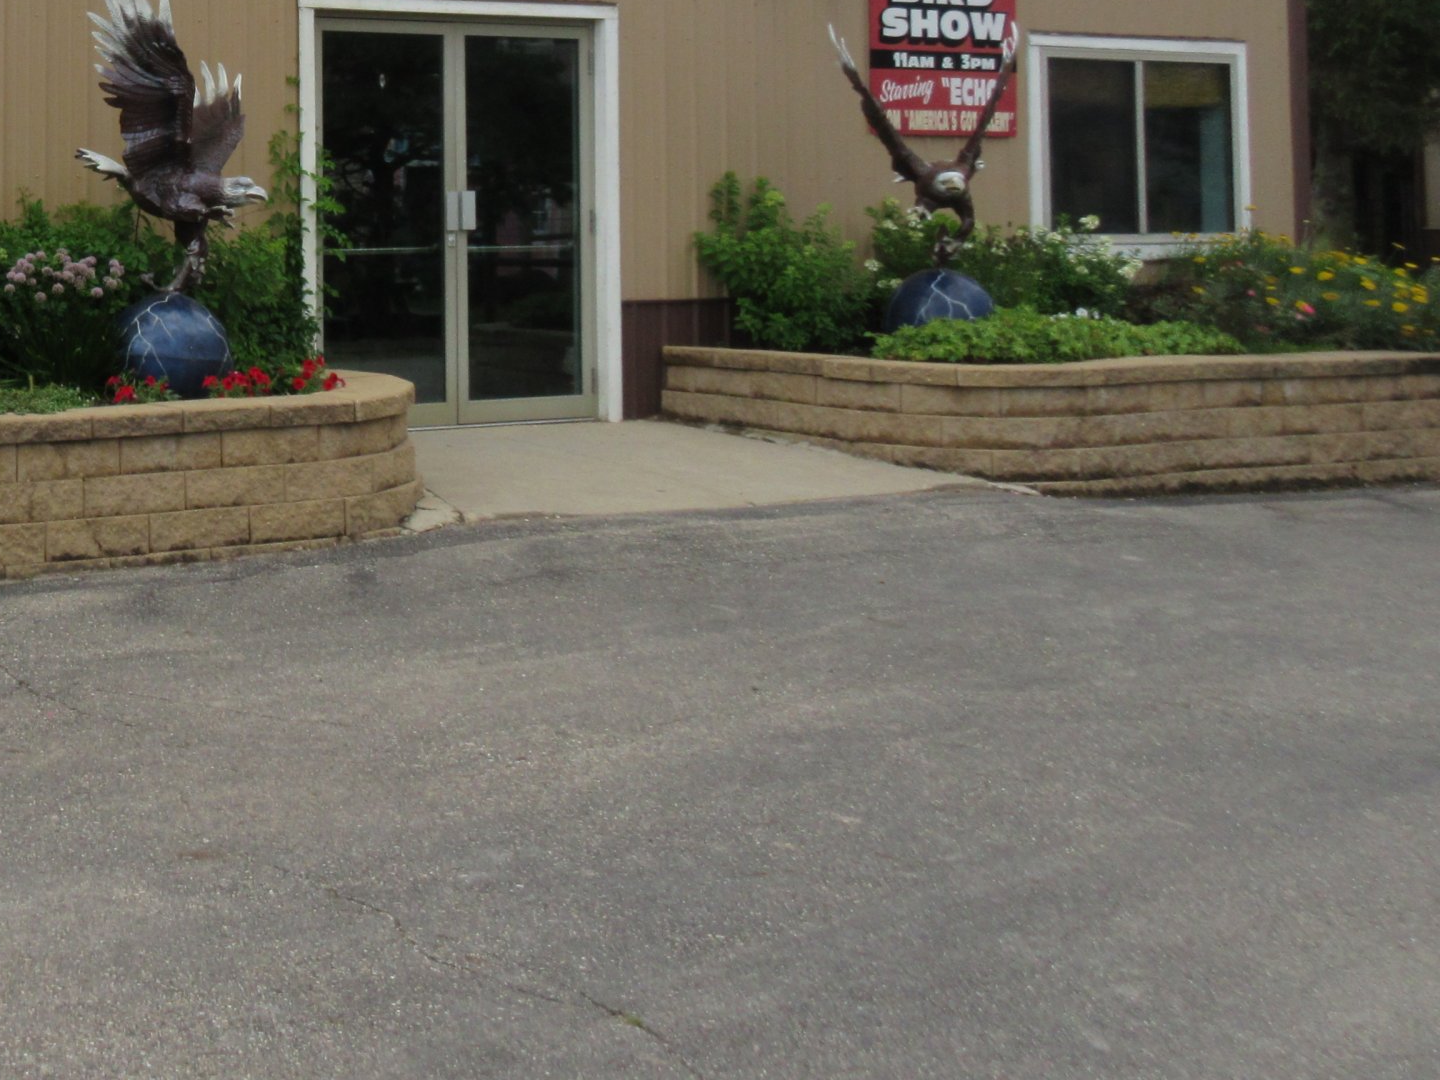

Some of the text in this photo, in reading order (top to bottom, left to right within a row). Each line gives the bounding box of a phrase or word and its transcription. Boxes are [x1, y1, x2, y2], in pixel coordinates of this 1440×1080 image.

[881, 7, 1006, 41] SHOW
[893, 52, 996, 70] 11AM & 3PM
[879, 75, 997, 106] Starring "ECH
